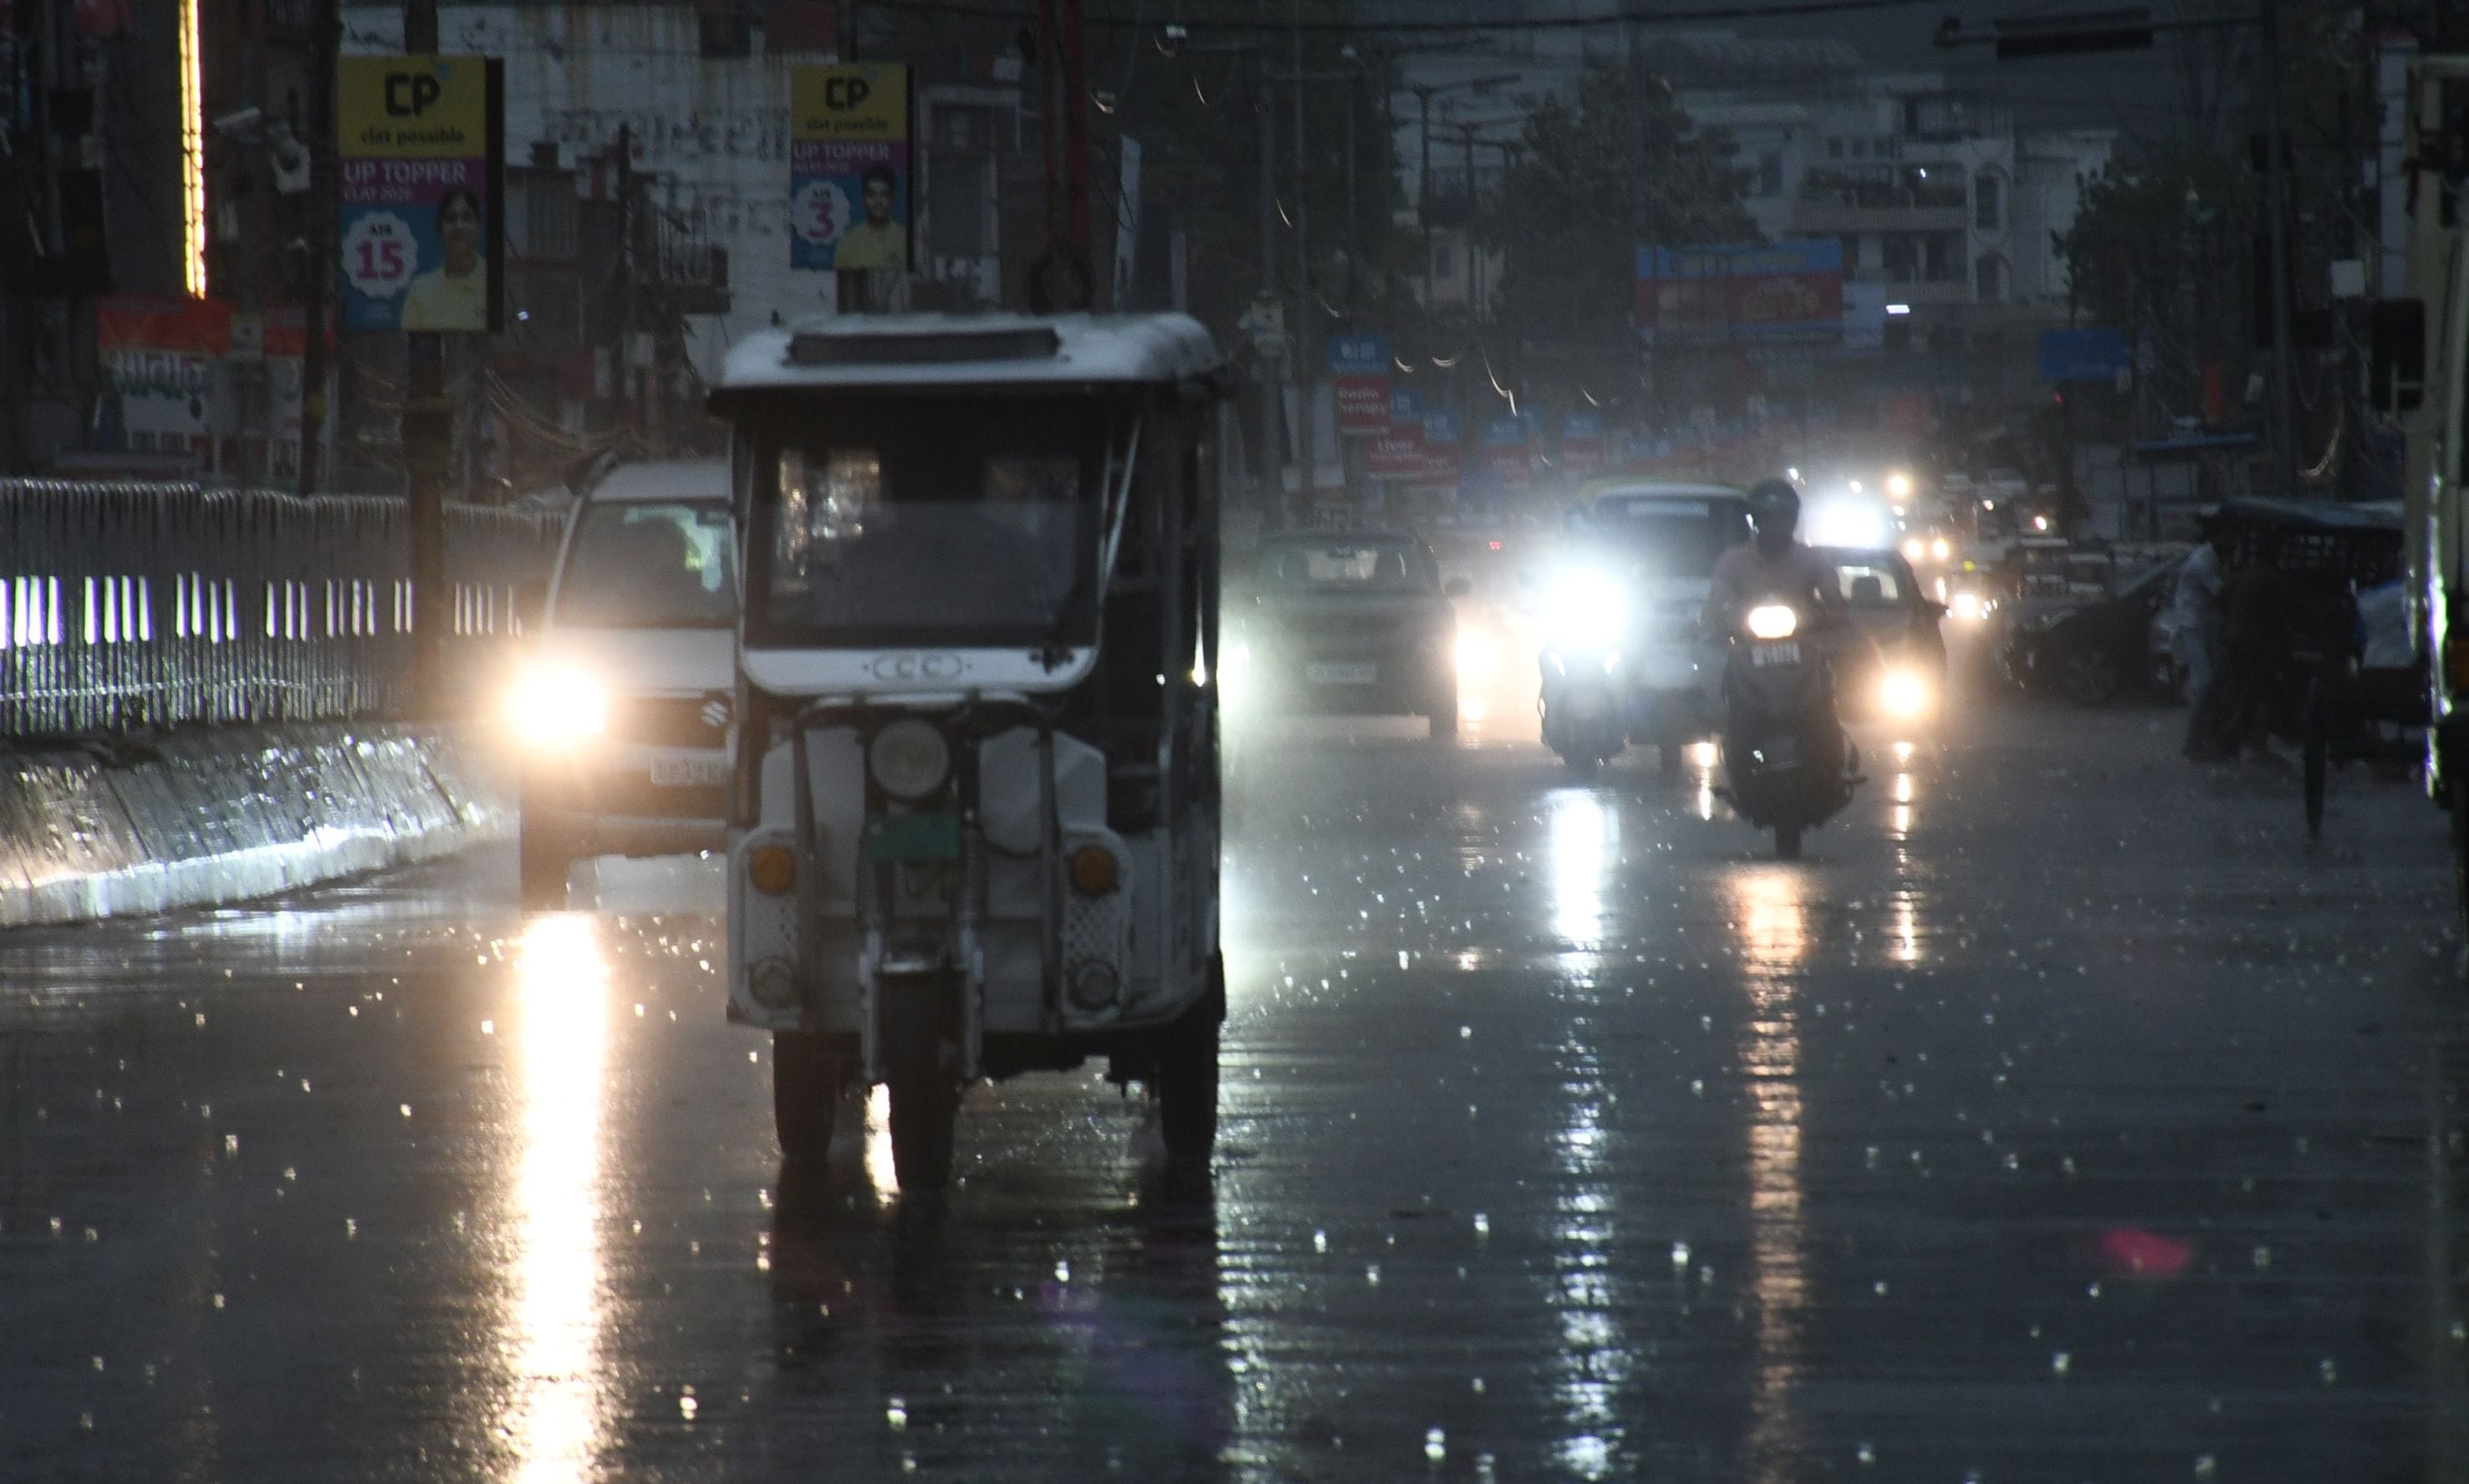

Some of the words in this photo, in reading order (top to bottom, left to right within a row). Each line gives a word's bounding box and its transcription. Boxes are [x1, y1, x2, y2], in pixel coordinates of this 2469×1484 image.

[385, 72, 441, 116] CP
[826, 77, 870, 110] CP
[361, 128, 390, 145] clat
[397, 127, 466, 148] possible
[793, 140, 815, 158] UP
[819, 140, 890, 161] TOPPER
[344, 160, 375, 184] UP
[380, 160, 467, 185] TOPPER
[809, 200, 834, 239] 3
[357, 240, 404, 280] 15
